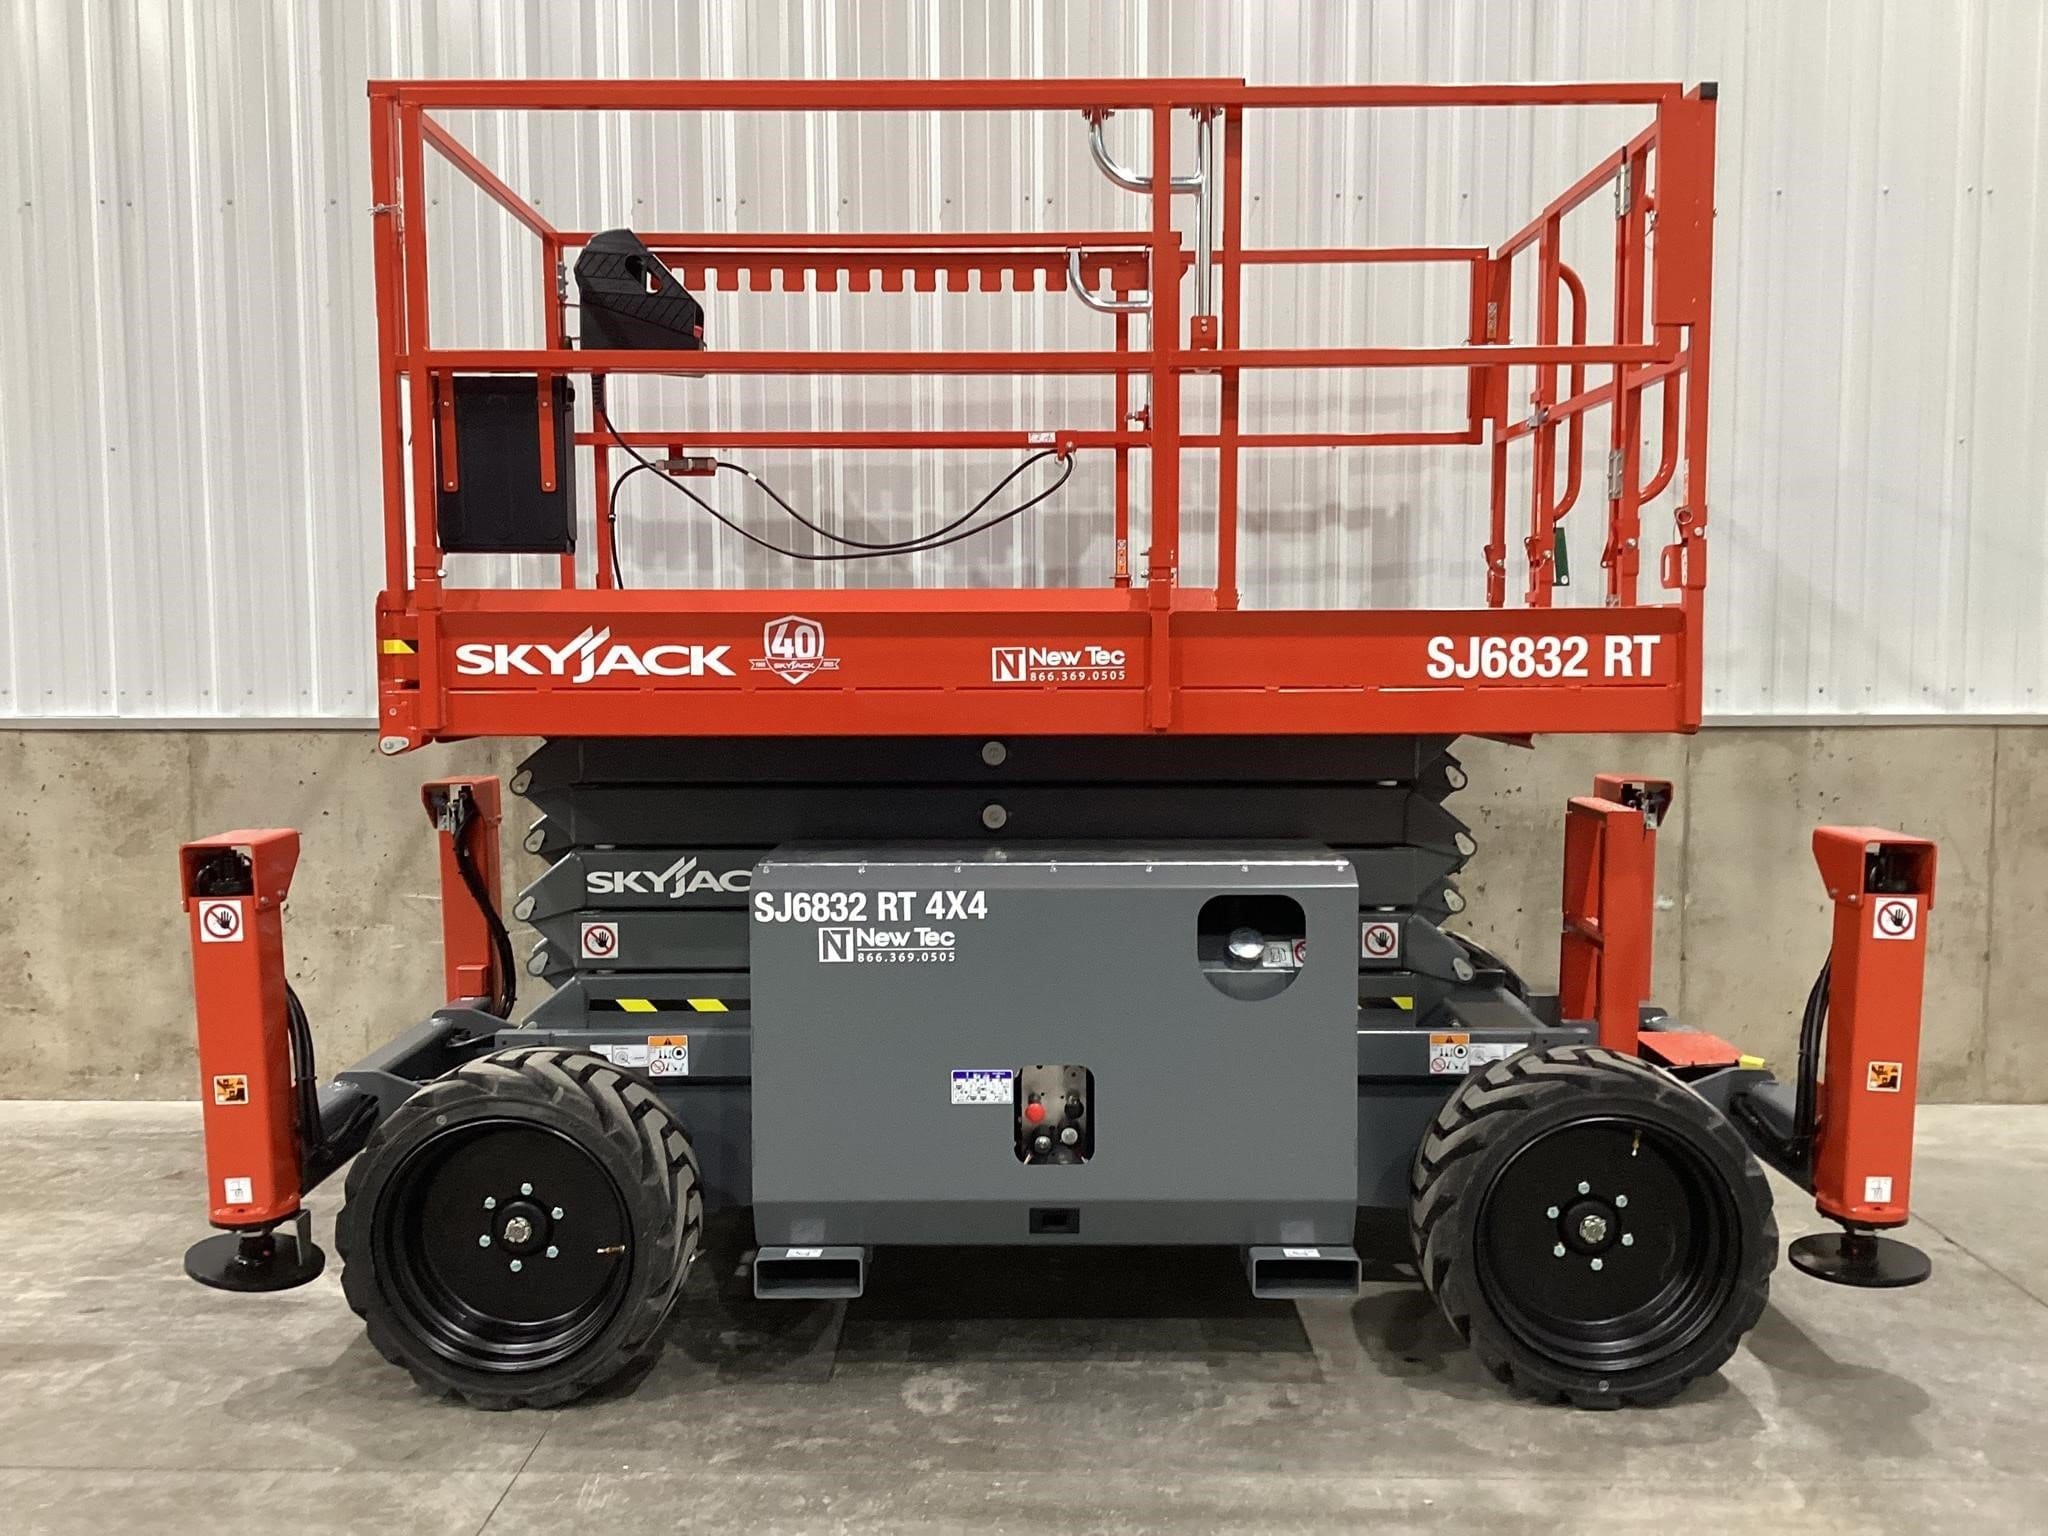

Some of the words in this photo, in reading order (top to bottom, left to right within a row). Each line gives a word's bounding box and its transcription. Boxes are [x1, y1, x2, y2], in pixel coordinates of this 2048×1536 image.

[455, 625, 737, 684] SKYJACK
[771, 623, 817, 658] 40
[1029, 646, 1081, 667] New
[1084, 645, 1126, 666] Tec
[1426, 635, 1589, 679] SJ6832
[1603, 634, 1661, 677] RT
[1030, 671, 1126, 681] 866.369.0505
[586, 856, 753, 899] SKYJAC
[754, 892, 867, 923] SJ6832
[877, 891, 917, 922] RT
[925, 890, 988, 920] 4X4
[856, 927, 911, 947] New
[913, 927, 956, 947] Tec
[857, 952, 956, 962] 866.369.0505
